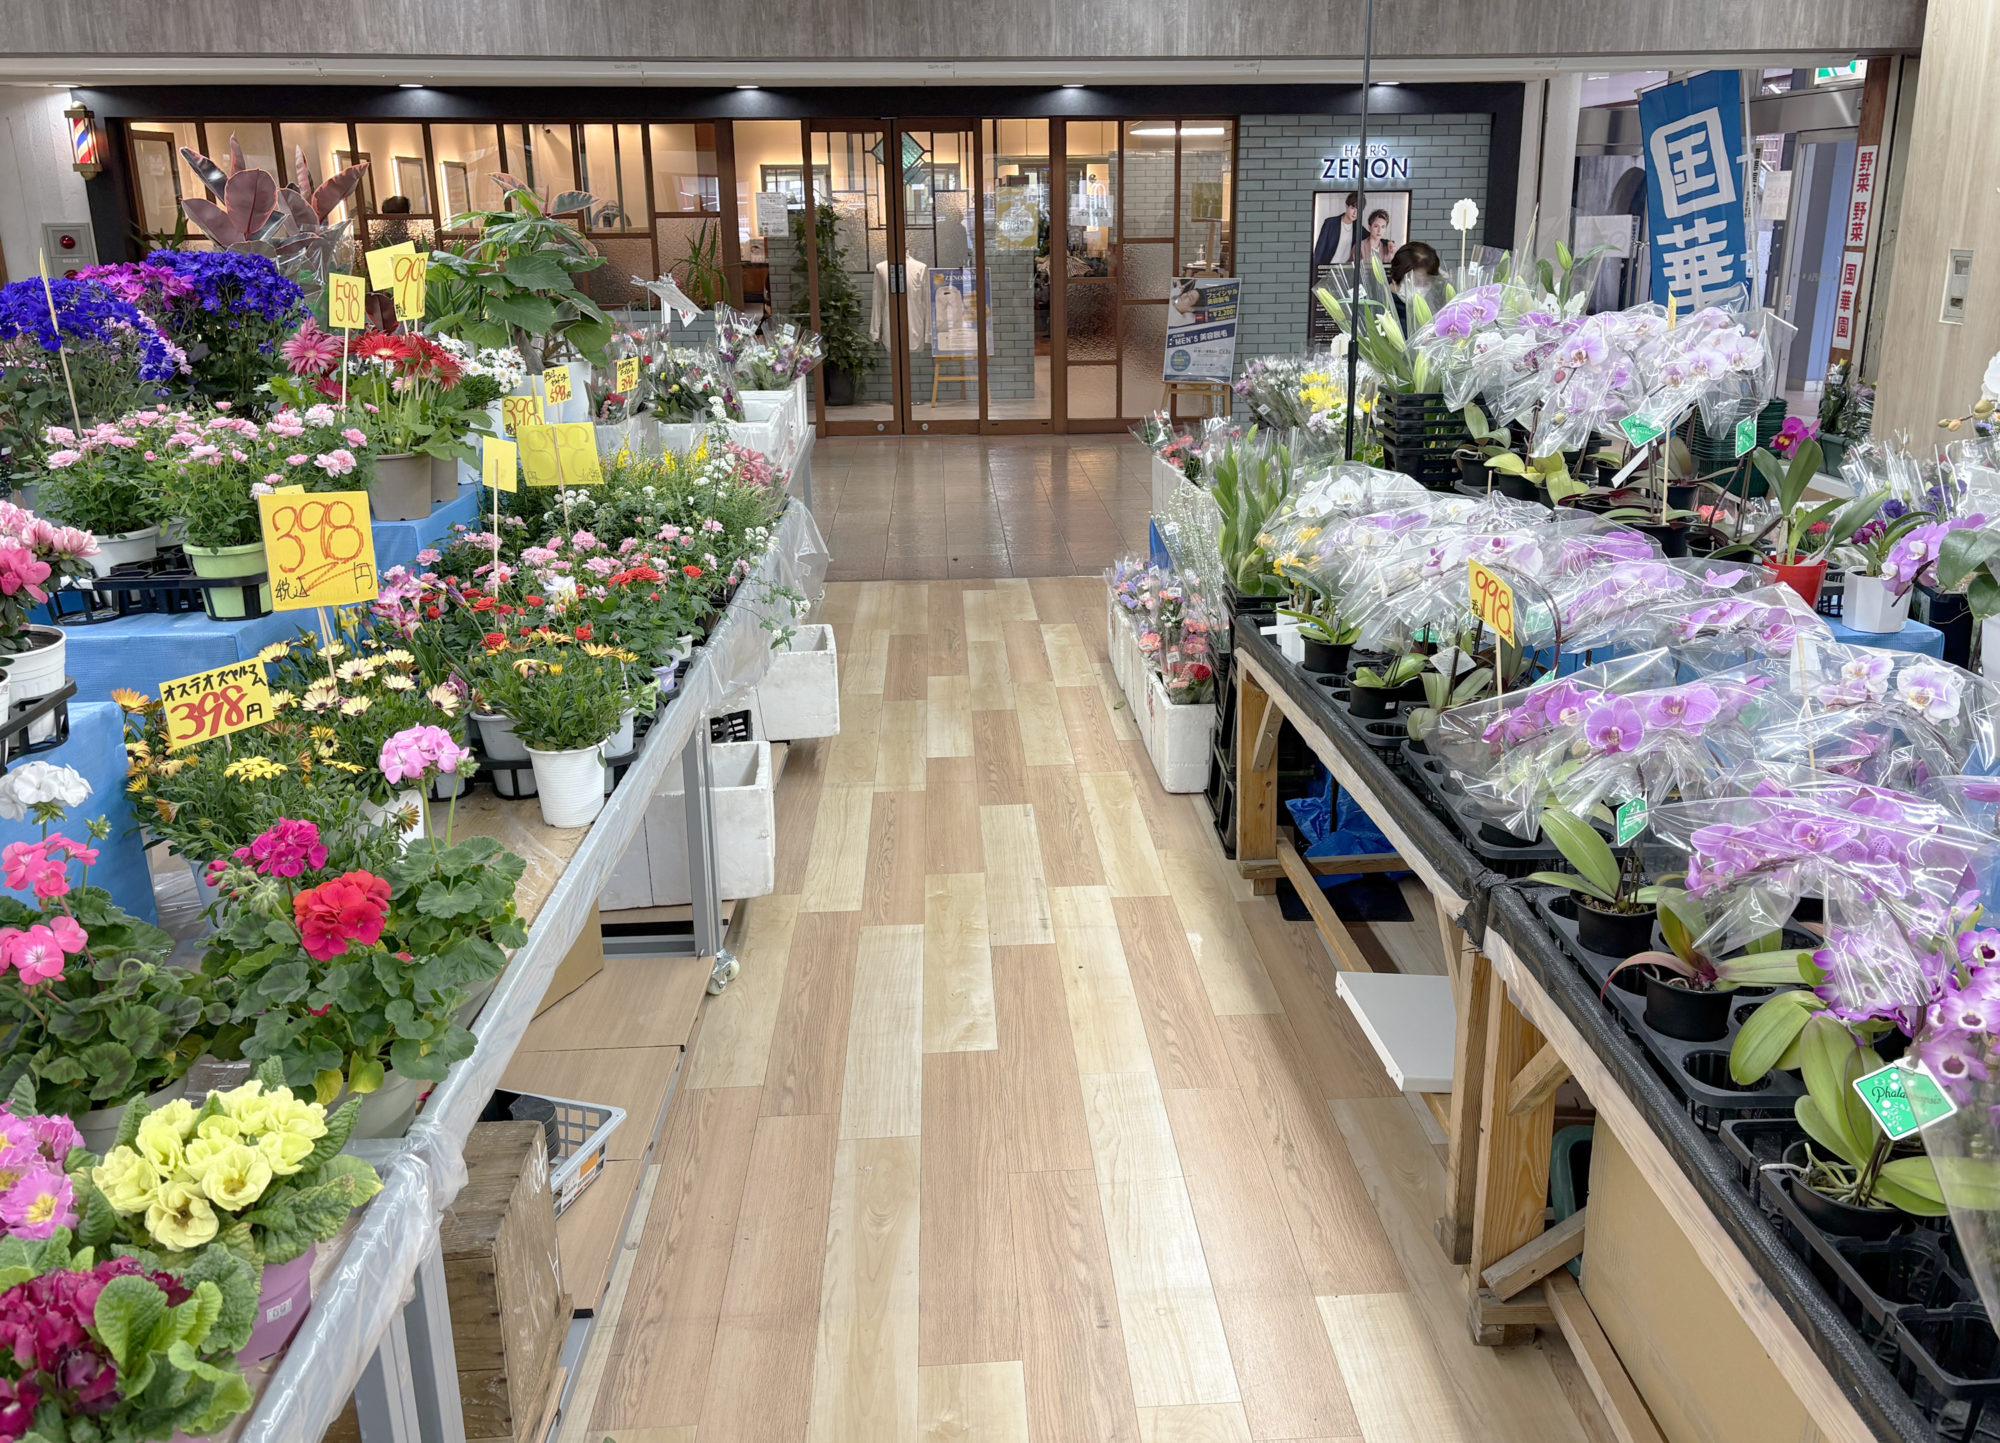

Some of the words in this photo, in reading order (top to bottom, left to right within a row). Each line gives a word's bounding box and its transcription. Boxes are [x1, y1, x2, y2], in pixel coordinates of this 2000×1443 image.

[1344, 145, 1388, 156] HAR'S
[1322, 158, 1408, 179] ZENON
[335, 278, 361, 323] 598
[1837, 264, 1857, 338] 国華園
[1175, 335, 1198, 345] MEN'S
[272, 501, 364, 573] 398
[275, 575, 310, 602] 税込
[353, 562, 373, 594] 円
[1475, 571, 1511, 634] 998
[163, 664, 267, 702] オステオスペルマム
